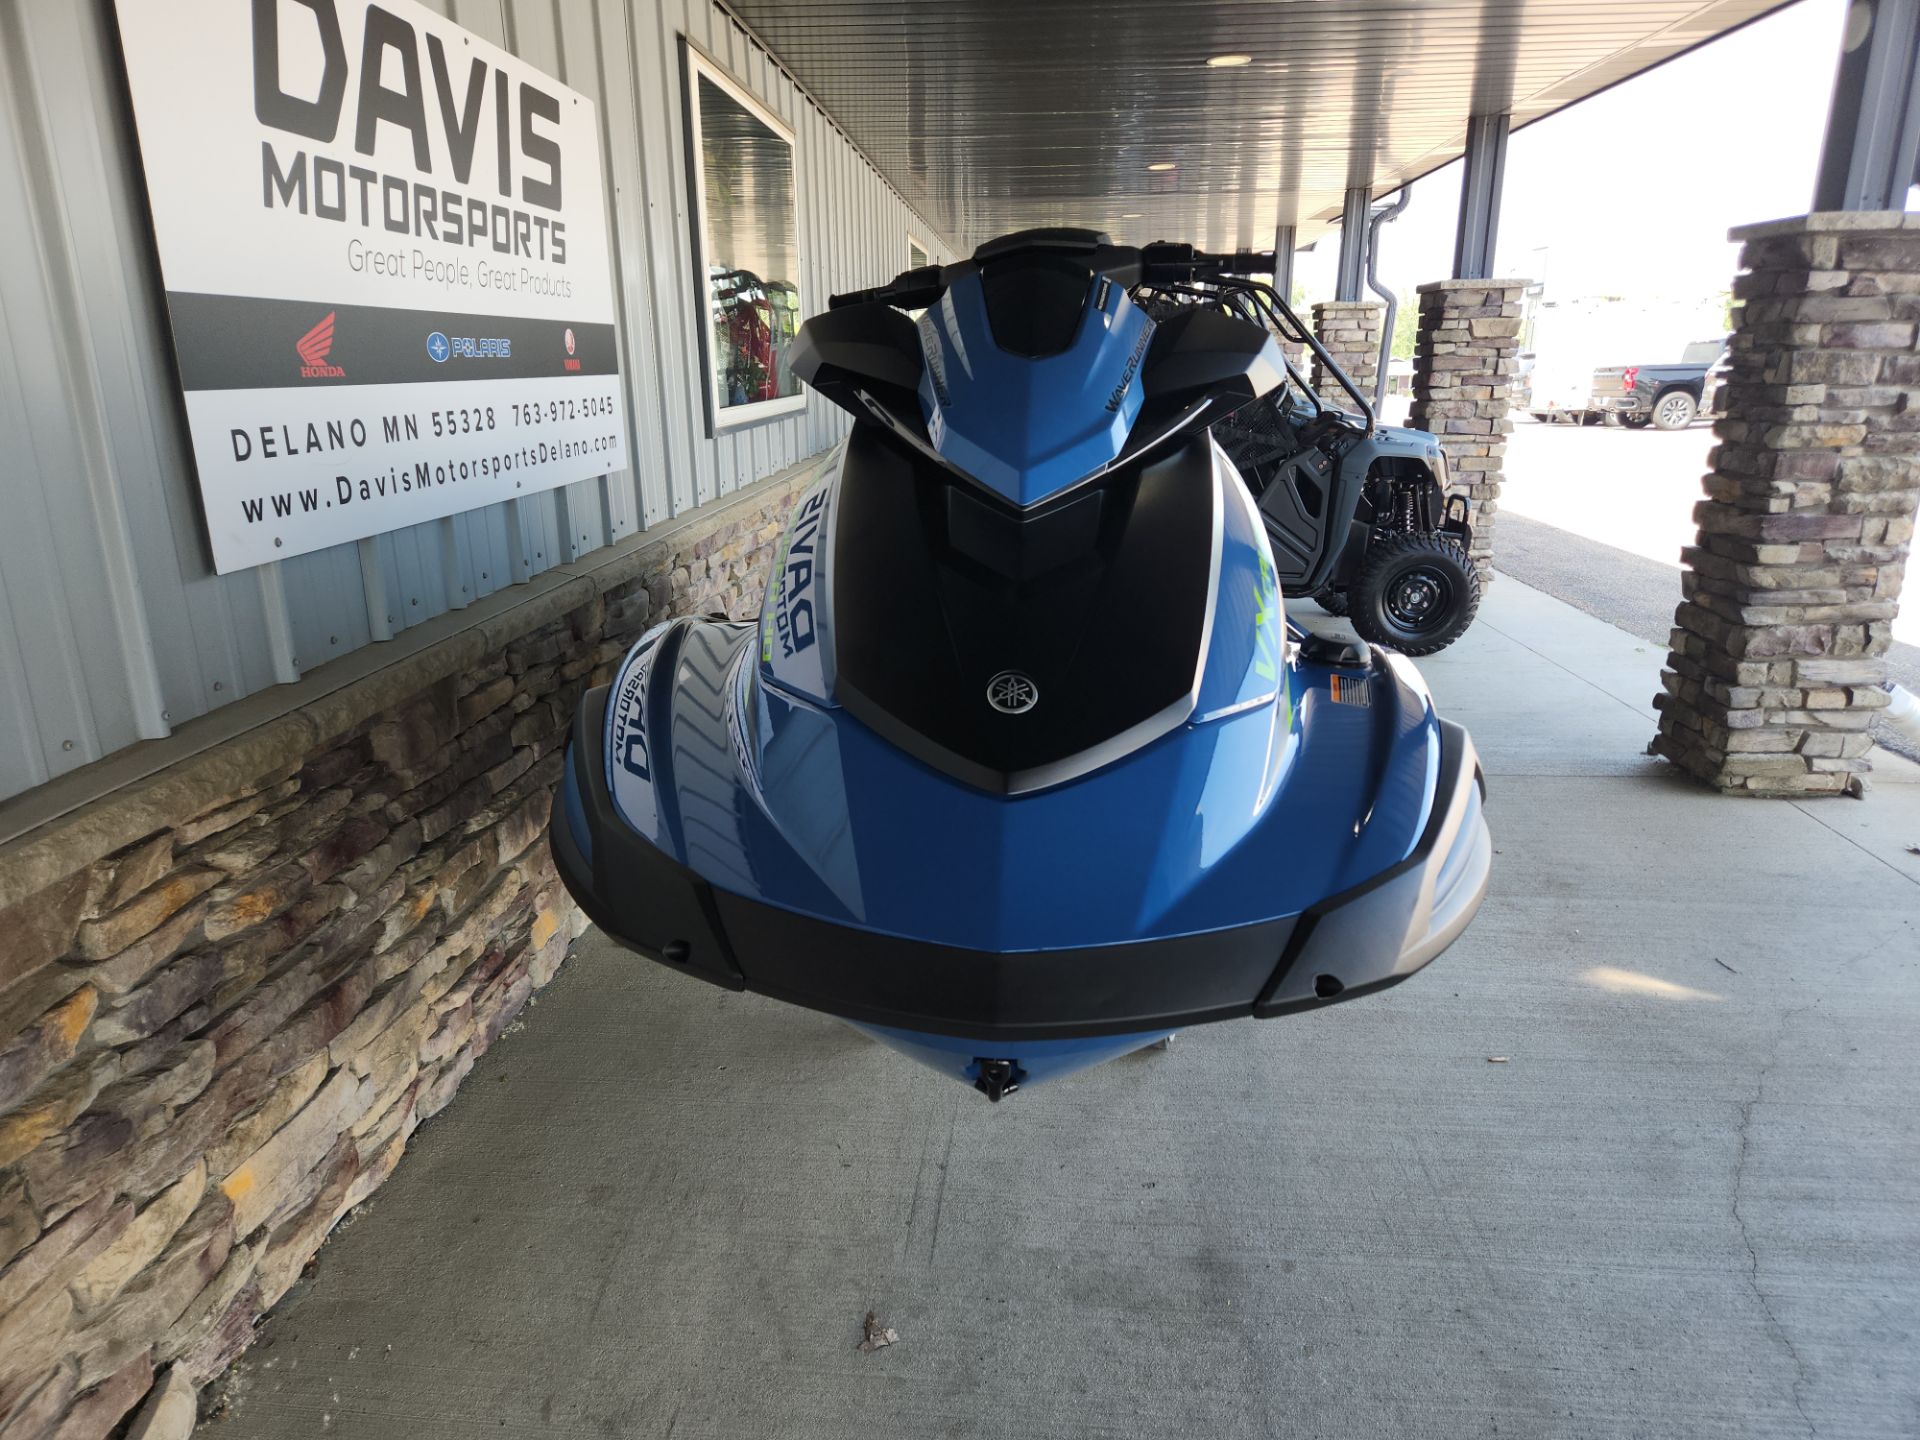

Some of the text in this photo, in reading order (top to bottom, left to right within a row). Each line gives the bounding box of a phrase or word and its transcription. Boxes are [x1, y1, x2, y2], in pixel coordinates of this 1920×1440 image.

[252, 0, 562, 212] DAVIS
[261, 141, 566, 264] MOTORSPORTS
[347, 238, 572, 299] Great People, Great Products
[301, 365, 346, 378] HONDA
[451, 336, 511, 359] POLARIS
[230, 396, 614, 462] DELANO MN 55328 763-972-5045
[241, 433, 618, 523] www.DavisMotorsportsDelano.com
